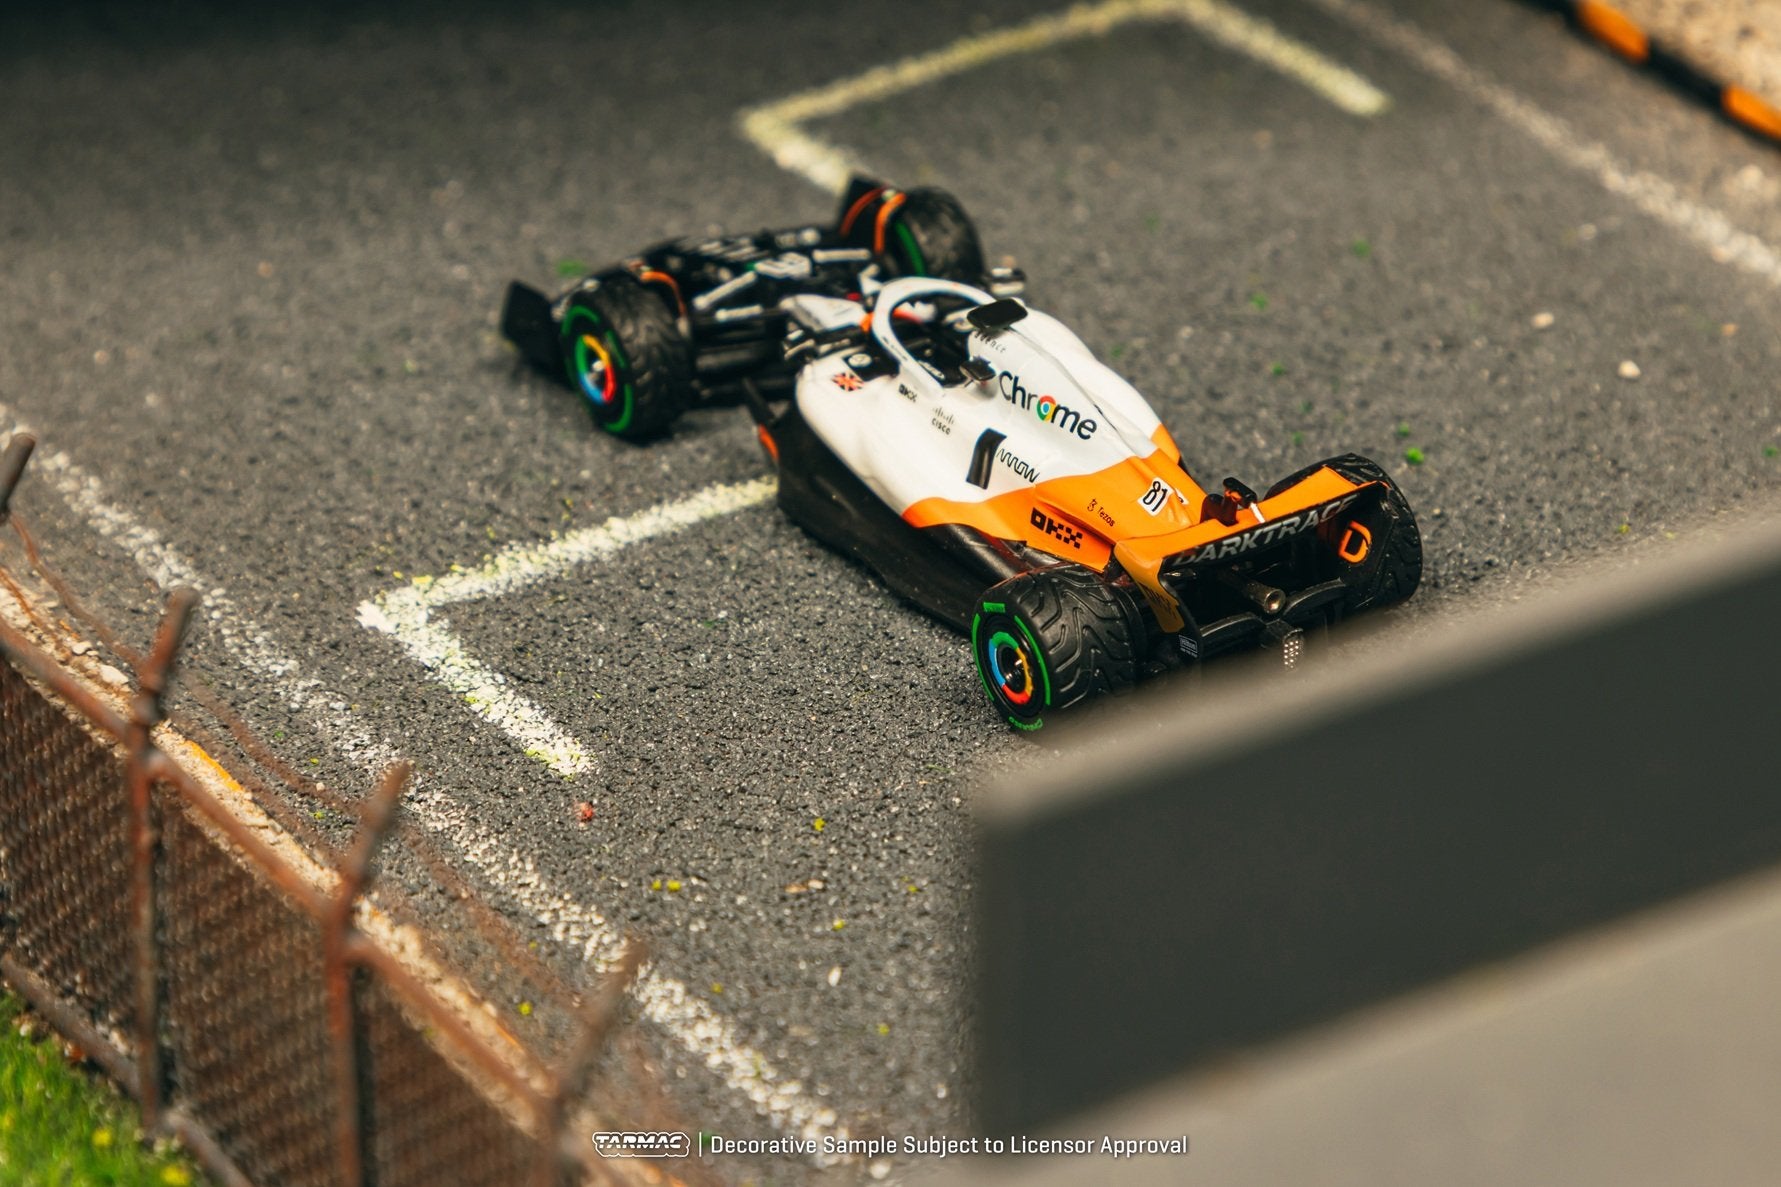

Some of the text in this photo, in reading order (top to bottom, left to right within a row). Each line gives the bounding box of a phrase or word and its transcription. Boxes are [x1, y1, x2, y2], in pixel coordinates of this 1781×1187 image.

[999, 370, 1097, 440] Chrome
[1142, 480, 1168, 513] 81
[1029, 506, 1083, 550] OKX
